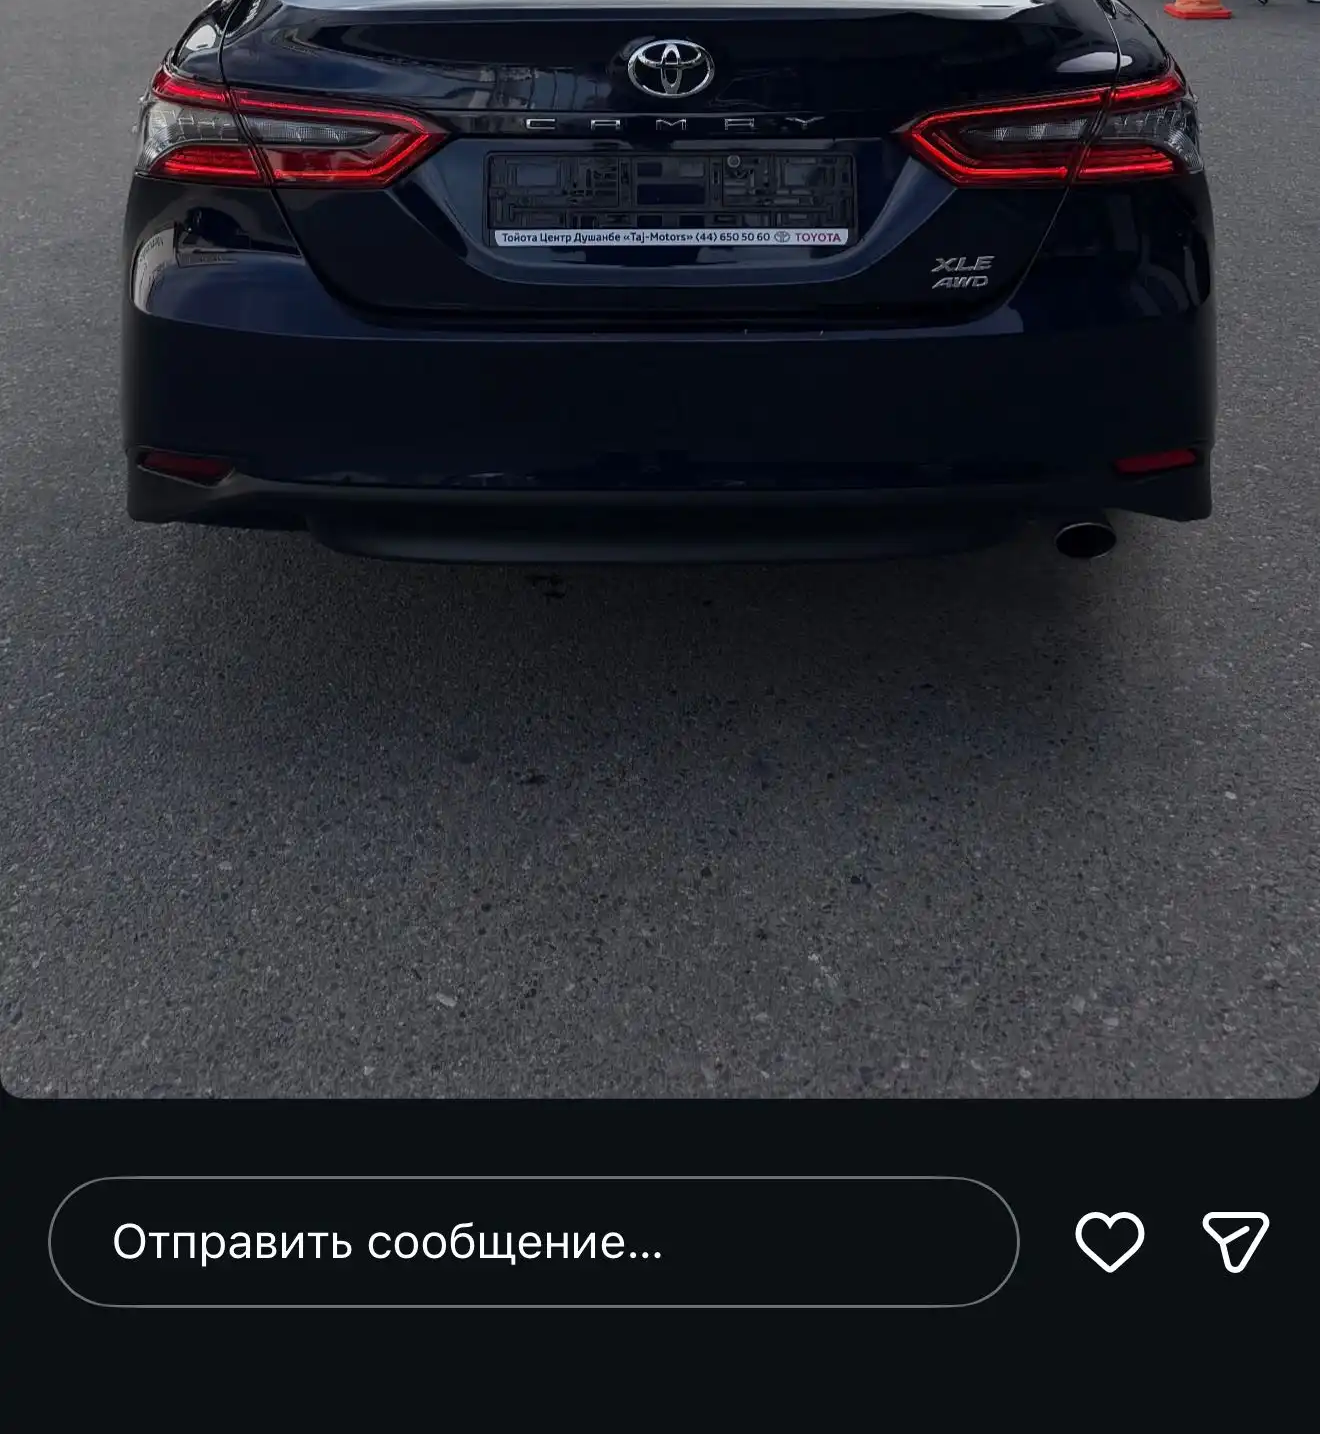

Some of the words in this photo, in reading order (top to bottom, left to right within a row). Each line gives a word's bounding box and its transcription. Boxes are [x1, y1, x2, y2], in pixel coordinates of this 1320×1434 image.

[525, 116, 826, 131] CAMRY
[502, 231, 538, 243] Тойота
[540, 231, 572, 244] Центр
[573, 231, 621, 244] Душанбе
[695, 231, 718, 243] (44)
[719, 231, 739, 242] 650
[741, 231, 755, 242] 50
[756, 231, 771, 242] 60
[795, 231, 842, 243] TOYOTA
[931, 255, 995, 273] XLE
[931, 275, 989, 290] AWD
